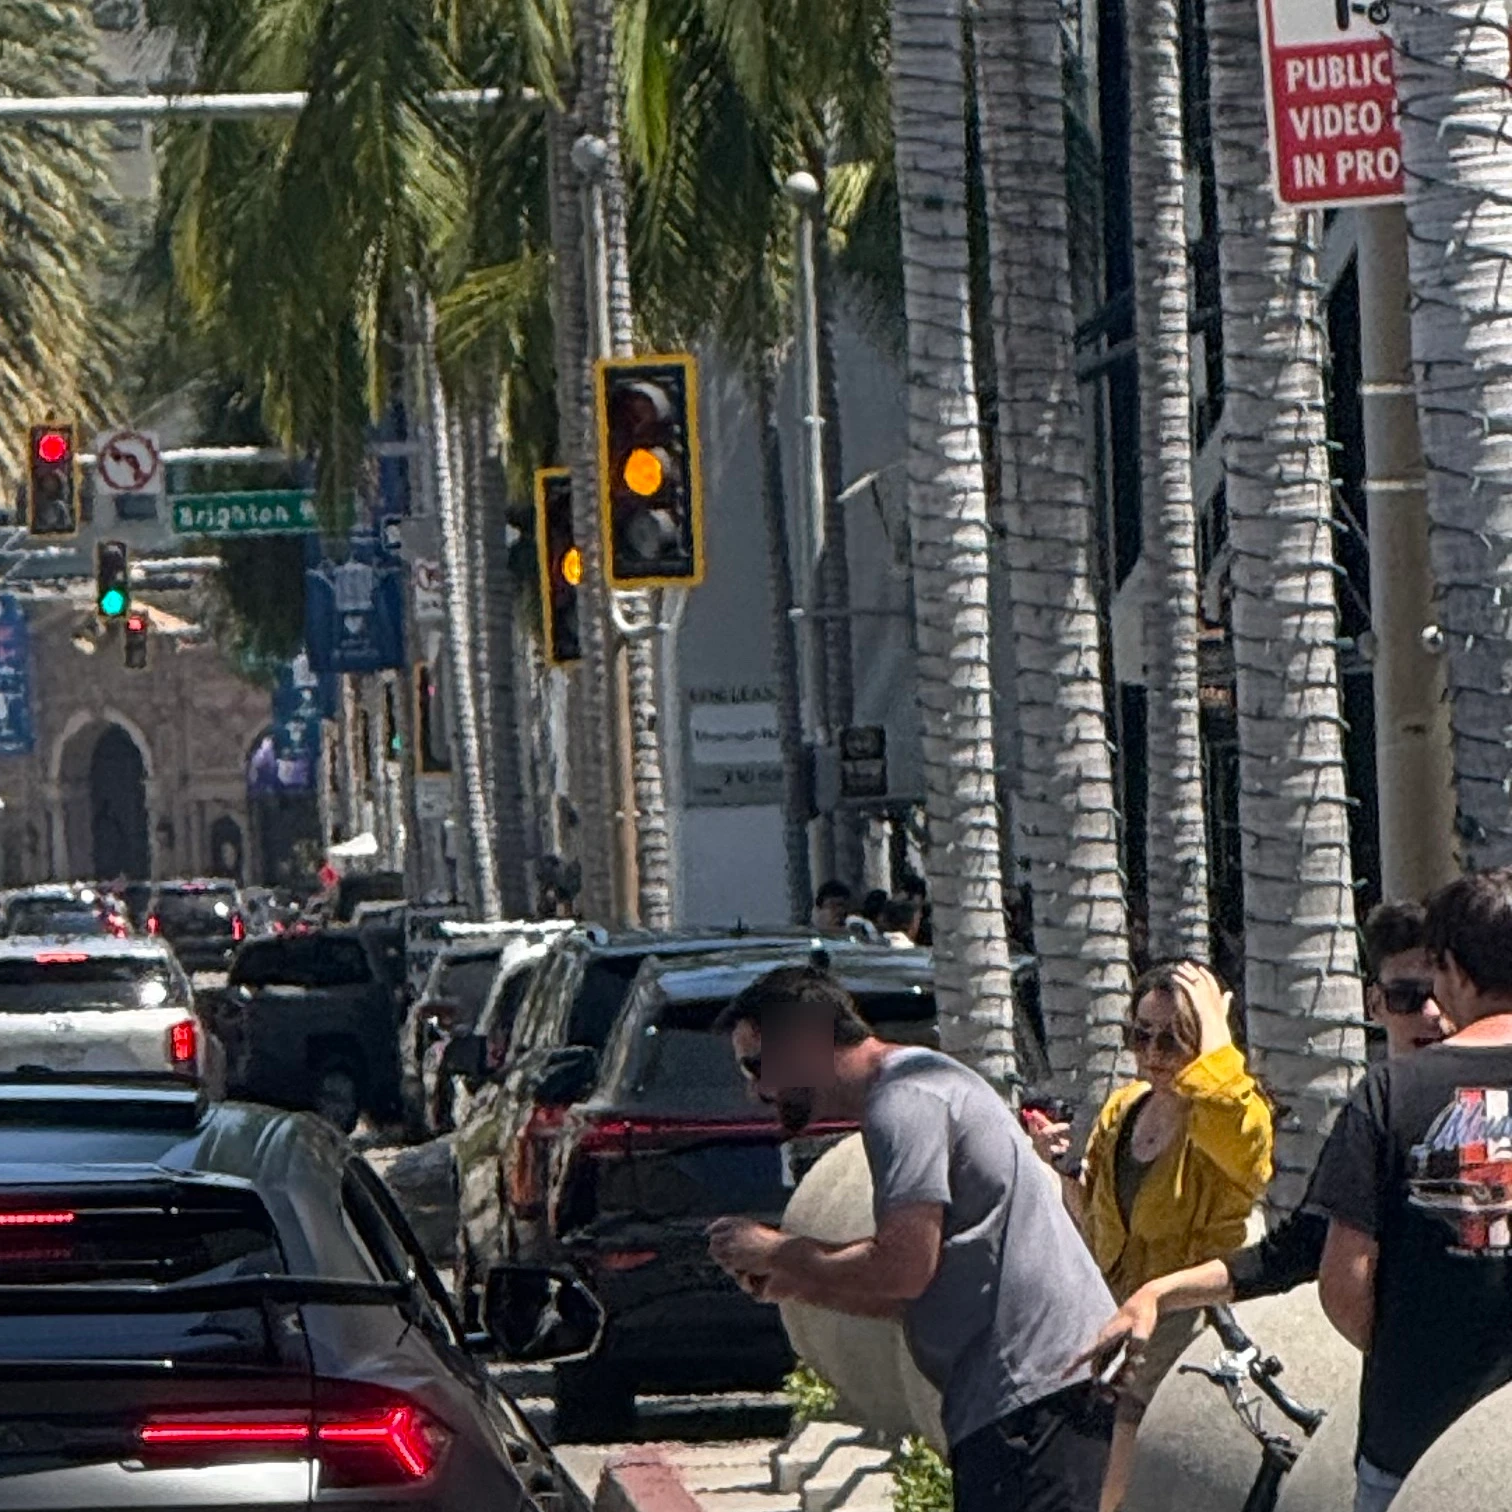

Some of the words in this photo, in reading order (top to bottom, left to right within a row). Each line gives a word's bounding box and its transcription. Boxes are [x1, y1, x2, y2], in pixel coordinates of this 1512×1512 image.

[1285, 51, 1392, 94] PUBLIC
[1289, 100, 1382, 142] VIDEO
[1292, 152, 1326, 190] IN
[178, 502, 289, 531] Brighton
